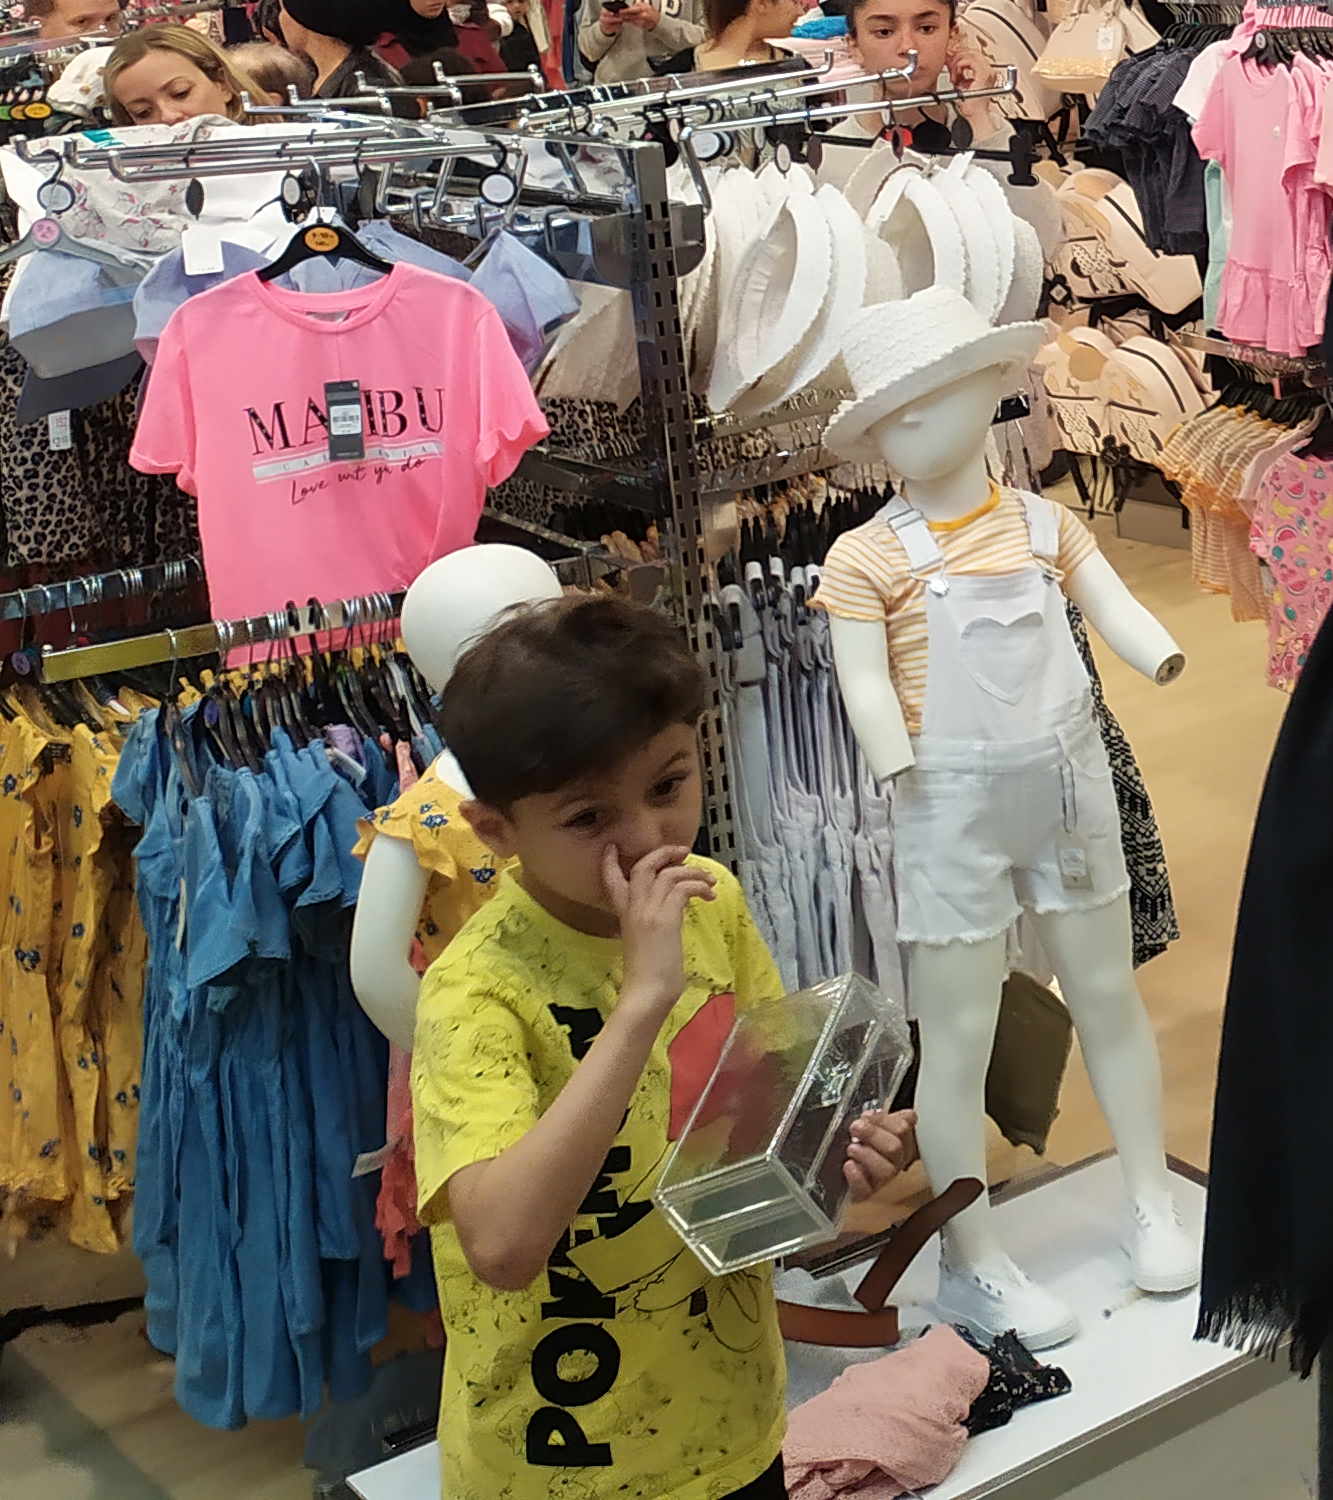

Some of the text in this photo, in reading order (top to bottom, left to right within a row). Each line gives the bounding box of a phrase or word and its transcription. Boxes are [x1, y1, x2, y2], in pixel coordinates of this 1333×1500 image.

[242, 385, 446, 456] MAIBU
[291, 478, 330, 506] Love
[526, 1002, 631, 1467] POKMN
